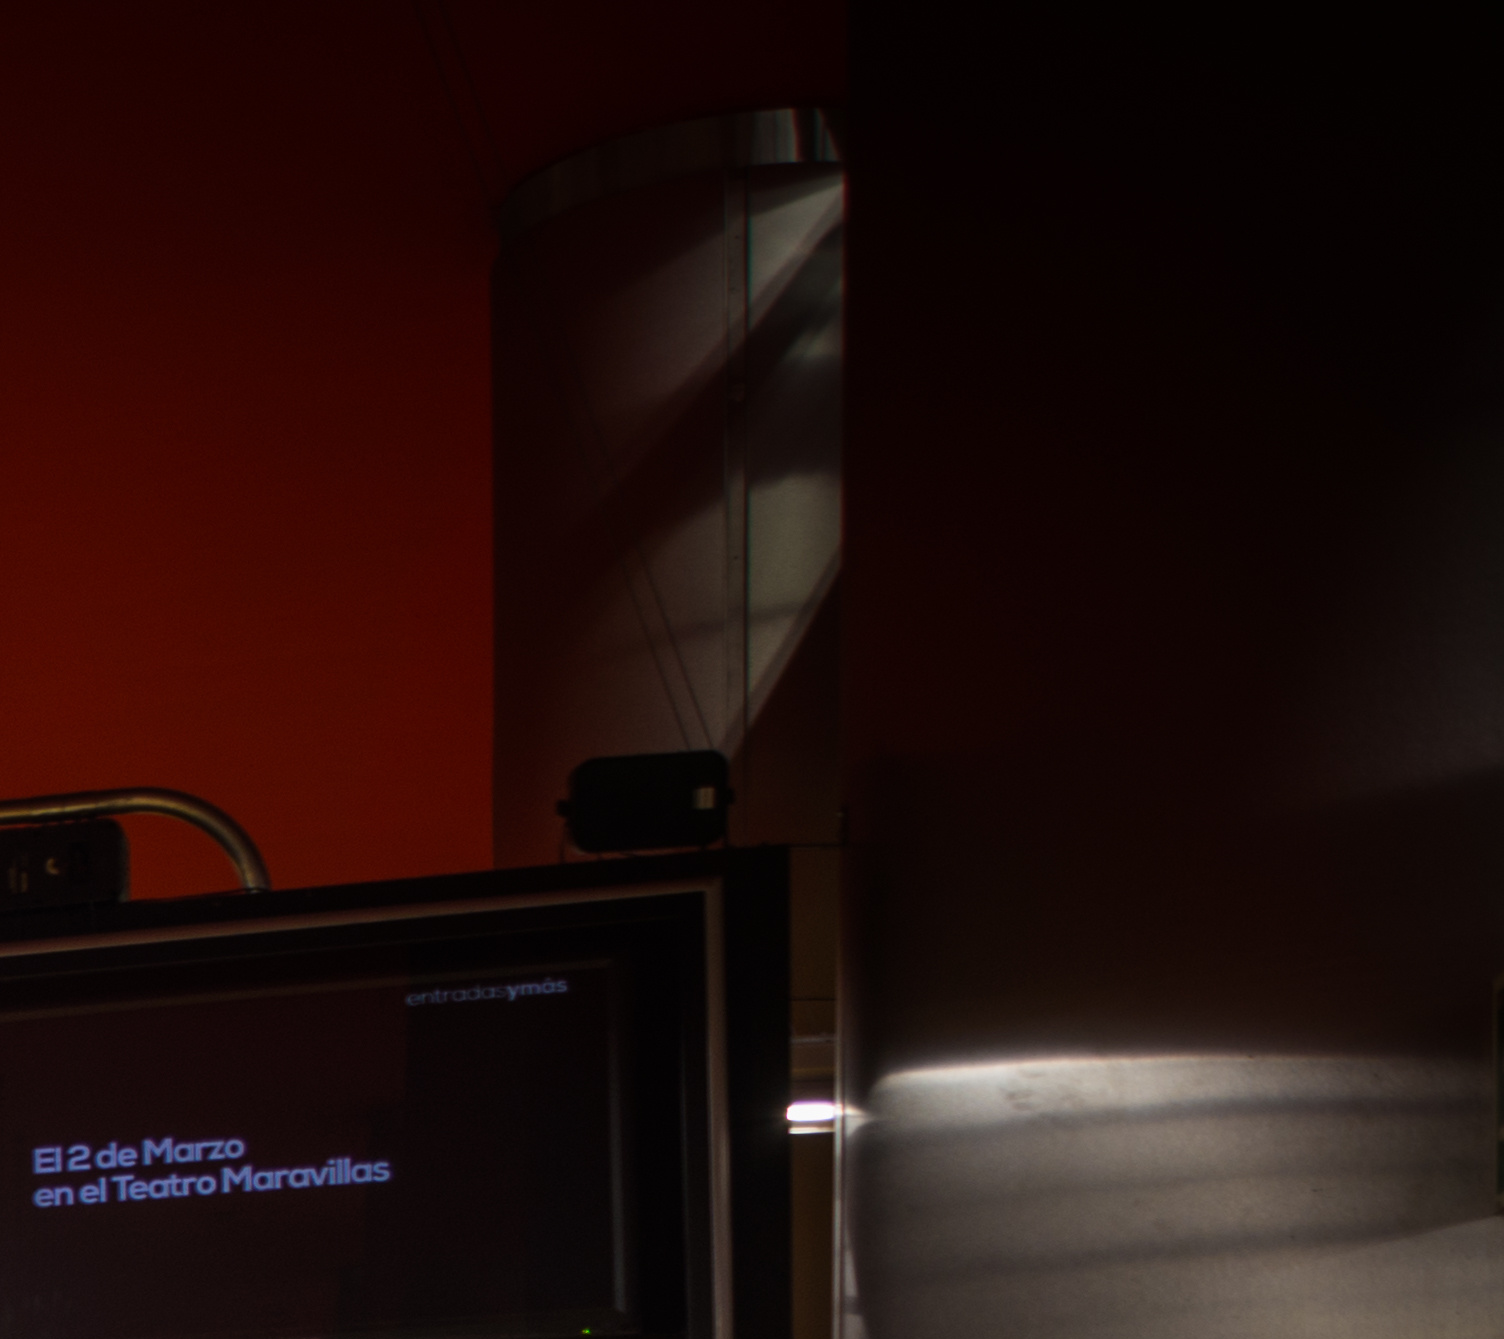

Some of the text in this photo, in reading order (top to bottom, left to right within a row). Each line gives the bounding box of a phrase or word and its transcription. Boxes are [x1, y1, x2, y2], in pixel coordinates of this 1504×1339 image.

[33, 1137, 245, 1174] El 2 de Marzo
[33, 1157, 390, 1207] en el Teatro Maravillas
